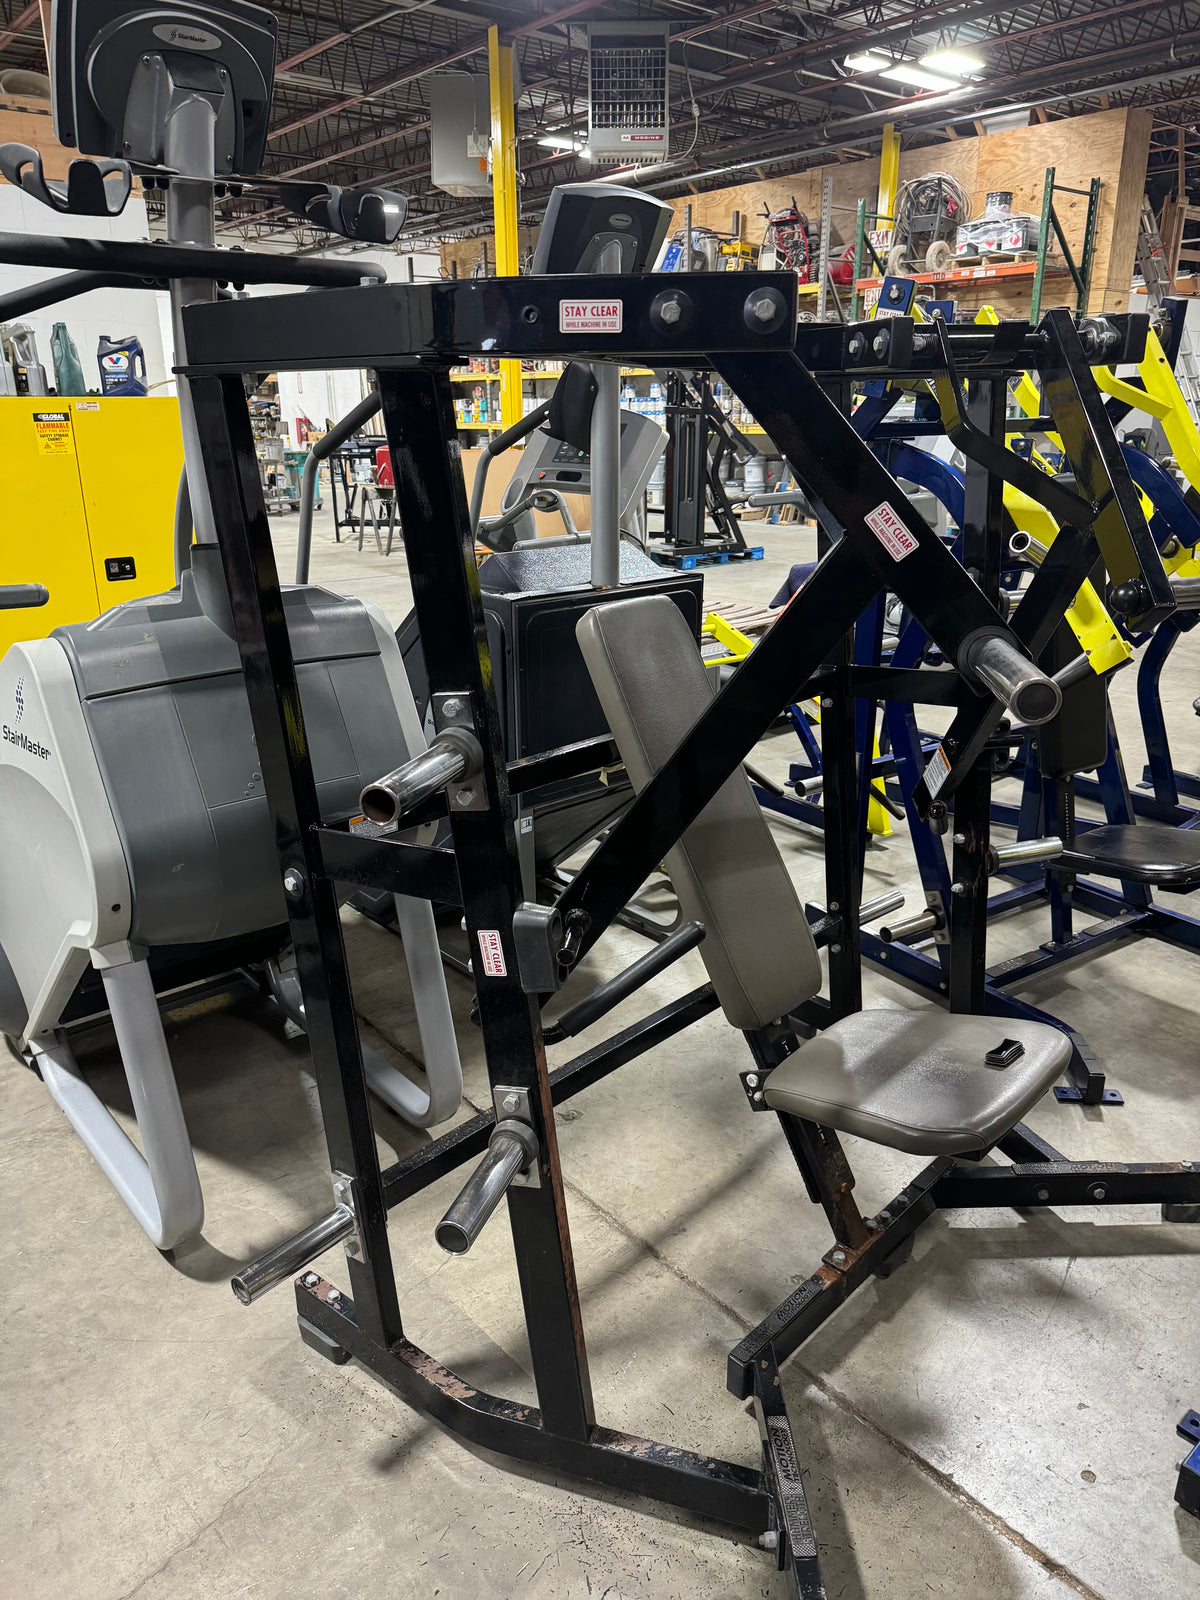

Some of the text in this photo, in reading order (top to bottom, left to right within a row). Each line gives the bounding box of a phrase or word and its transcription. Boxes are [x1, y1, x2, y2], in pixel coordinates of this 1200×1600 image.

[869, 230, 891, 245] EXIT
[564, 305, 618, 317] STAY CLEAR
[877, 508, 913, 551] STAY CLEAR
[3, 724, 50, 760] StairMaster
[488, 933, 503, 973] STAY CLEAR
[1070, 1163, 1114, 1171] MOTION
[776, 1286, 807, 1321] MOTION
[781, 1290, 813, 1323] TECHNOLOGY
[770, 1426, 793, 1481] MOTION
[779, 1427, 800, 1482] TECHNOLOGY
[784, 1494, 802, 1542] HAMMER
